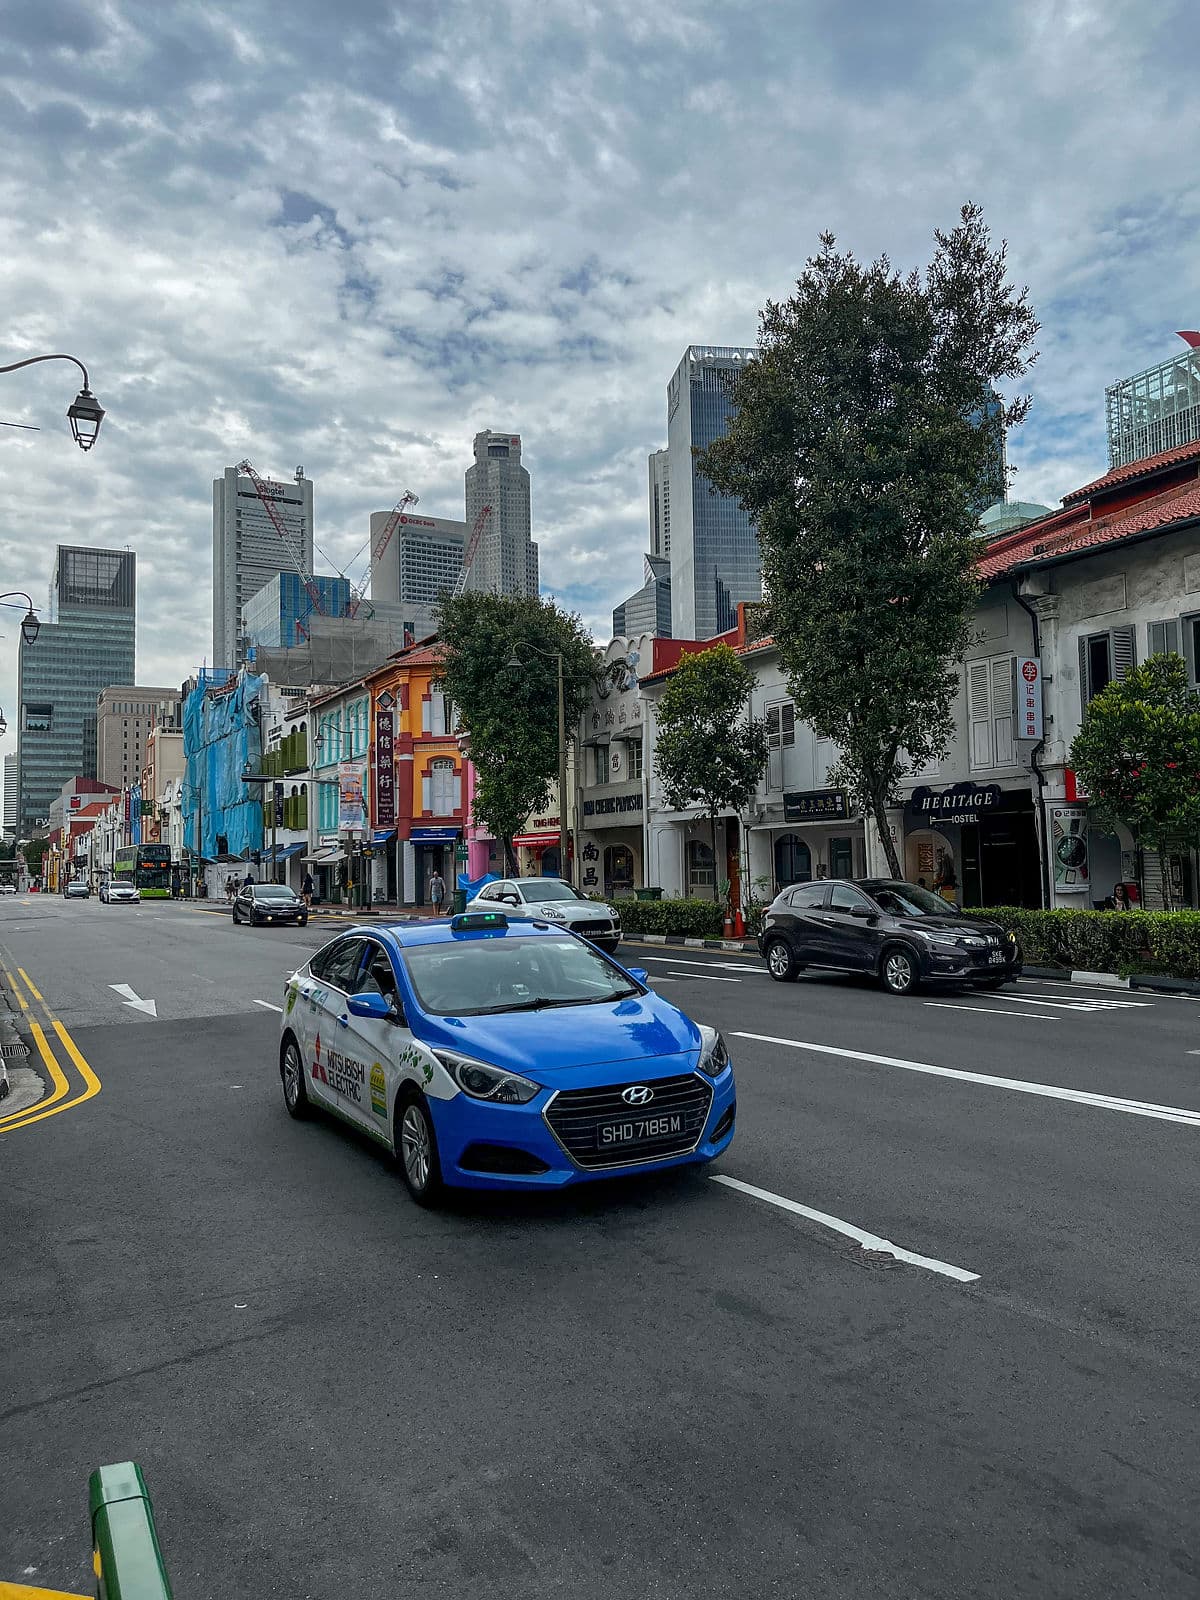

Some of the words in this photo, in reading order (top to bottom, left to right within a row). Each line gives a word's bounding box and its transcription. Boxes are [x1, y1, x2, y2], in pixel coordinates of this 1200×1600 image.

[615, 793, 644, 813] PAWNSHO
[922, 792, 993, 810] HERITAGE
[327, 1049, 366, 1084] MITSUBISHI
[328, 1069, 362, 1102] ELECTRIC
[602, 1123, 633, 1143] SHD
